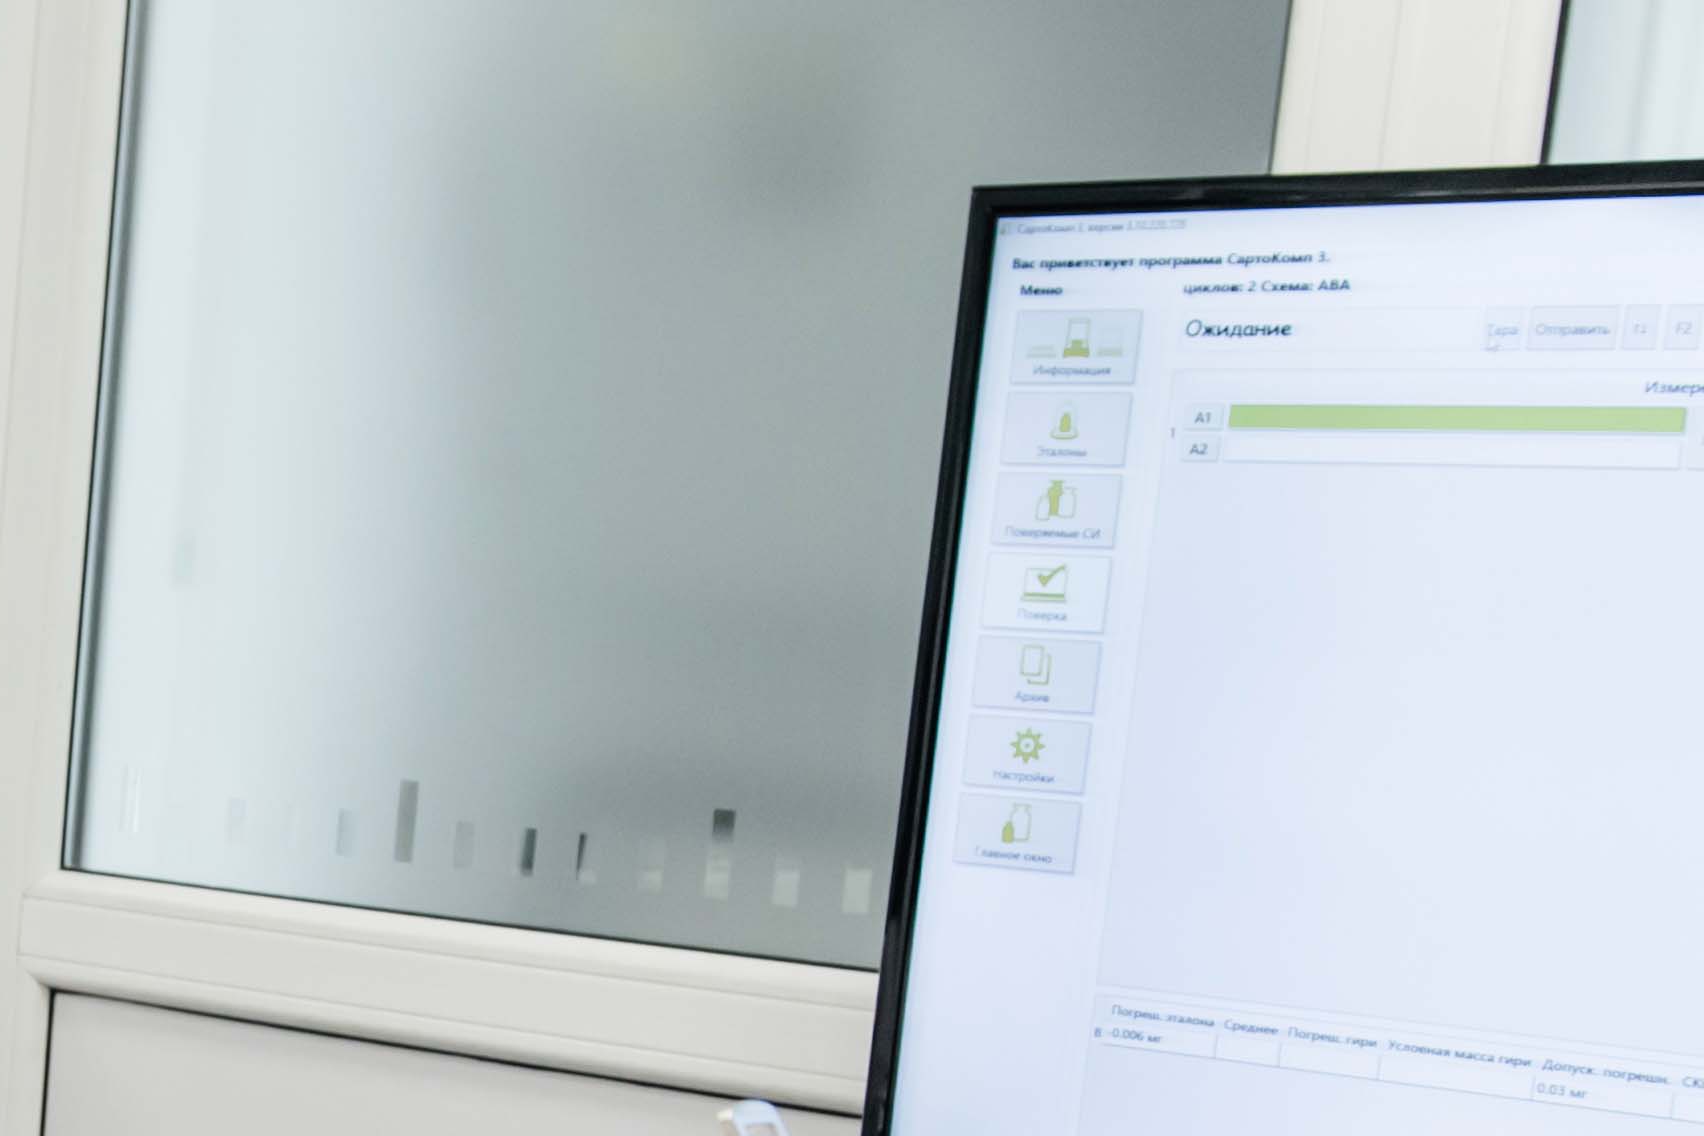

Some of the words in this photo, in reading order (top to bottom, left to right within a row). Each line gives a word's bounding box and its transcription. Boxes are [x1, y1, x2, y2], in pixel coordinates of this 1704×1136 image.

[1012, 257, 1035, 270] Вас
[1039, 257, 1134, 272] приветствует
[1139, 256, 1222, 271] программа
[1227, 251, 1313, 268] СартоКомп
[1020, 284, 1064, 296] Меню
[1183, 282, 1244, 295] циклов:
[1247, 280, 1258, 293] 2
[1261, 279, 1314, 293] Схема:
[1185, 318, 1293, 338] Ожидание
[1535, 322, 1611, 337] Отправить
[992, 769, 1056, 784] Настройки
[1223, 1018, 1279, 1037] Среднее
[1388, 1039, 1452, 1058] Условная
[1453, 1049, 1496, 1064] масса
[1498, 1055, 1533, 1069] гири
